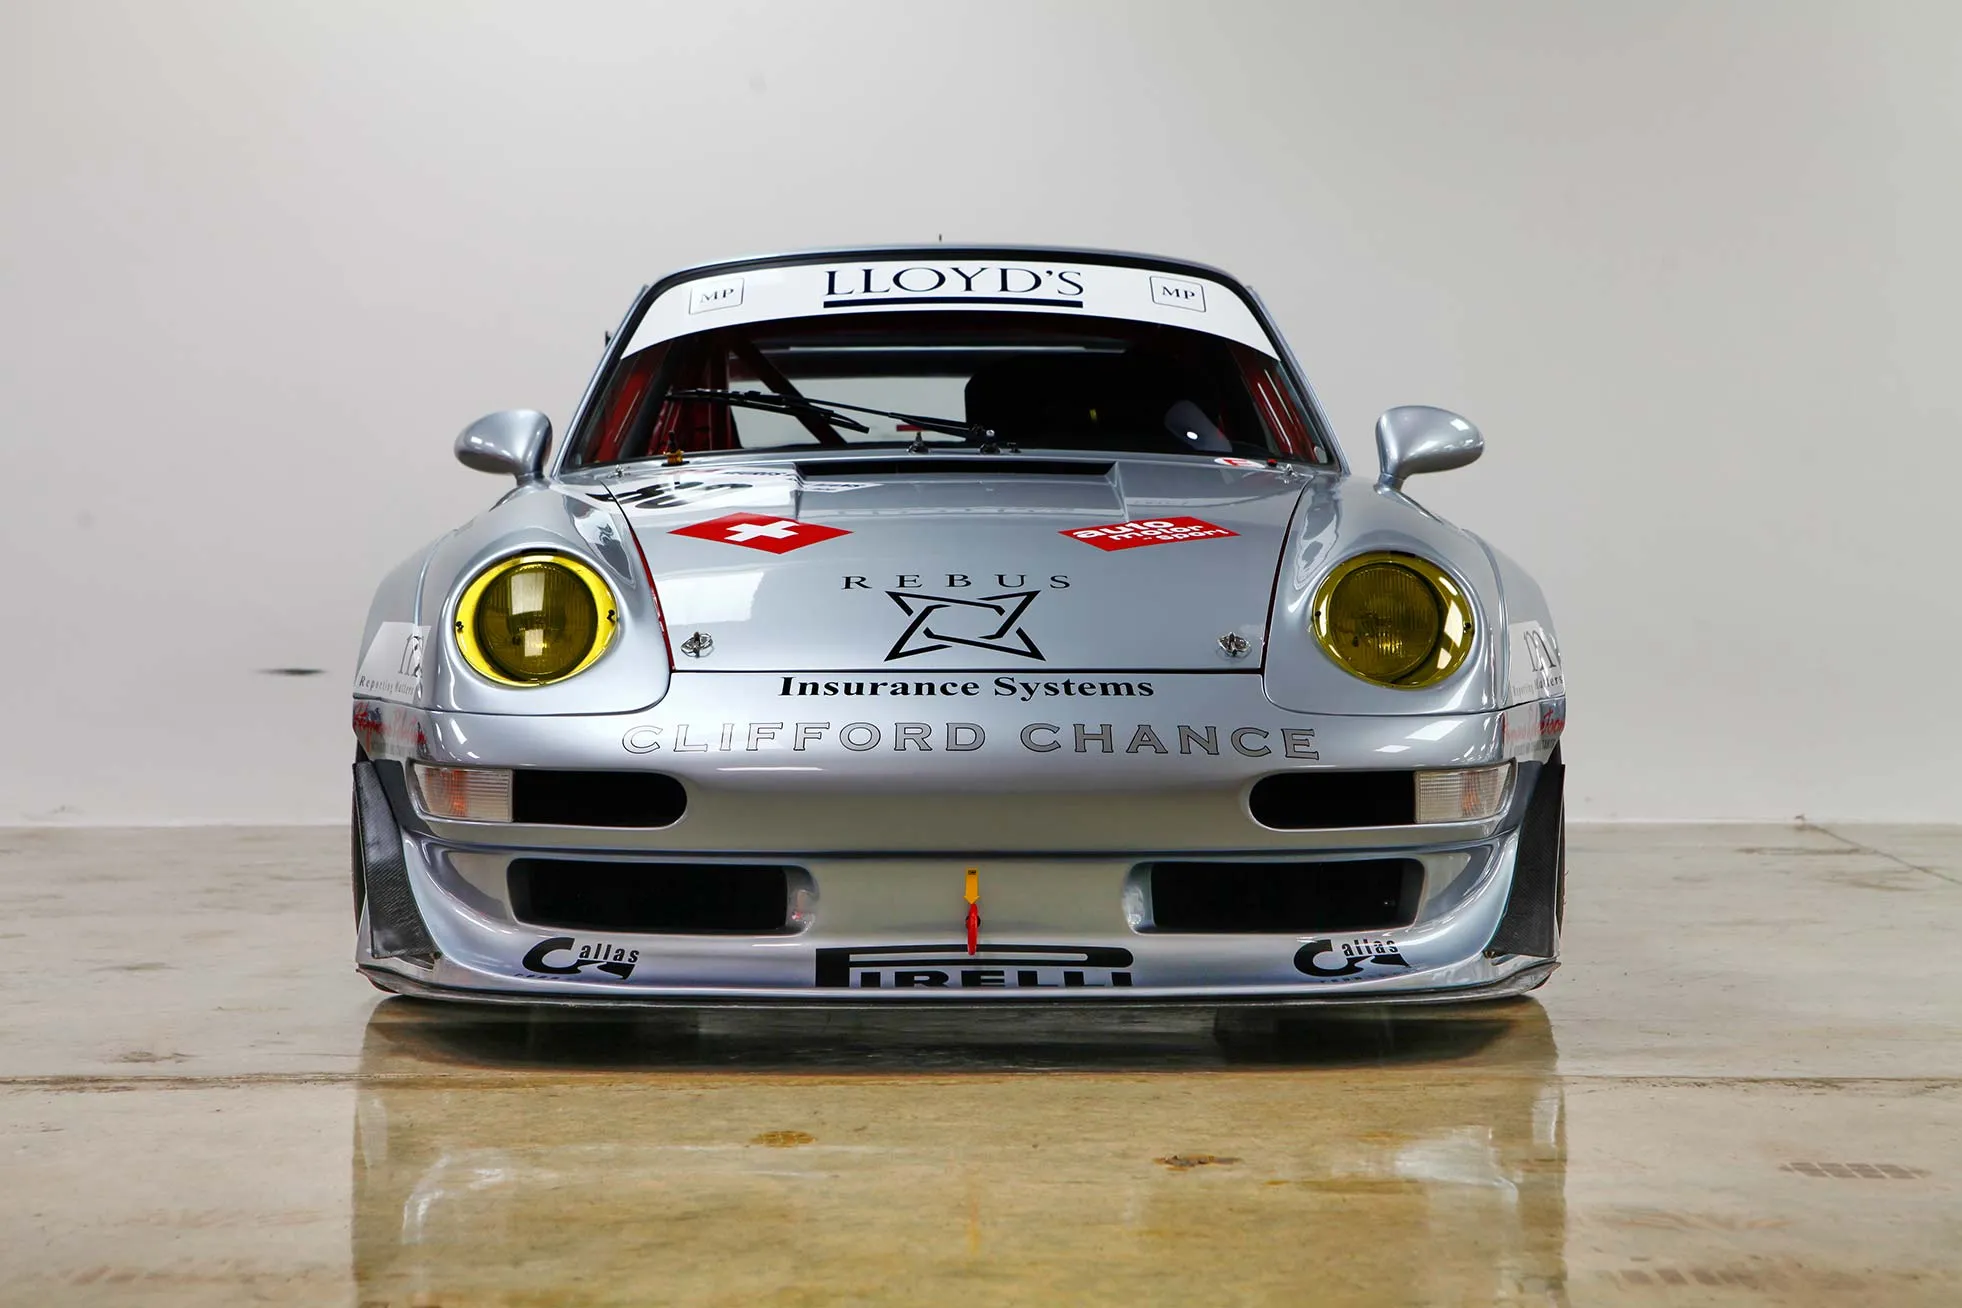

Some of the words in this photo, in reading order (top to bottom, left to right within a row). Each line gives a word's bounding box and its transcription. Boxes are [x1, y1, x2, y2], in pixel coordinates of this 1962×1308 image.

[700, 288, 735, 302] MP
[826, 267, 1084, 296] LLOYD'S
[1162, 286, 1195, 300] MP
[1073, 521, 1175, 539] auto
[841, 574, 1071, 590] REBUS
[778, 676, 980, 697] Insurance
[994, 676, 1154, 702] Systems
[622, 722, 986, 754] CLIFFORD
[1020, 723, 1319, 760] CHANCE
[522, 937, 640, 975] Callas
[816, 944, 1134, 987] PIRELLI
[1293, 939, 1399, 977] Callas
